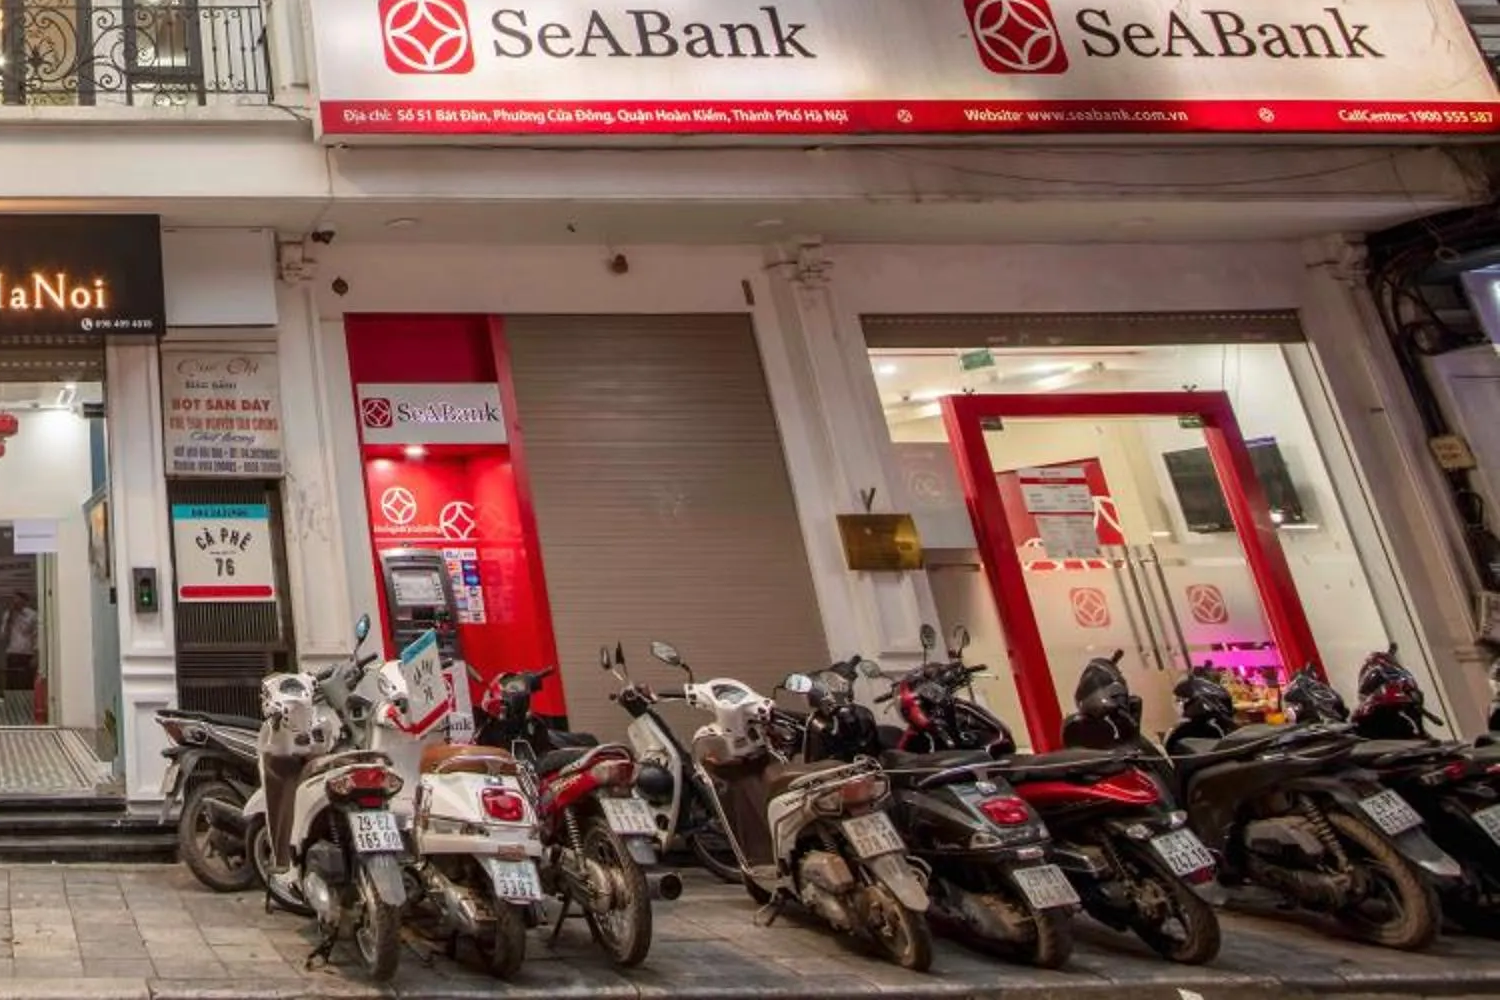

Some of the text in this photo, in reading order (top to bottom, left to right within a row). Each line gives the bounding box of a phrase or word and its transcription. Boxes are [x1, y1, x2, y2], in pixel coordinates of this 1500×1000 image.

[493, 6, 816, 59] SeABank
[1076, 7, 1385, 59] SeABank
[417, 110, 432, 121] 51
[1027, 108, 1189, 121] www.seabank.com.vn
[397, 401, 500, 422] SeABank
[215, 558, 235, 577] 76
